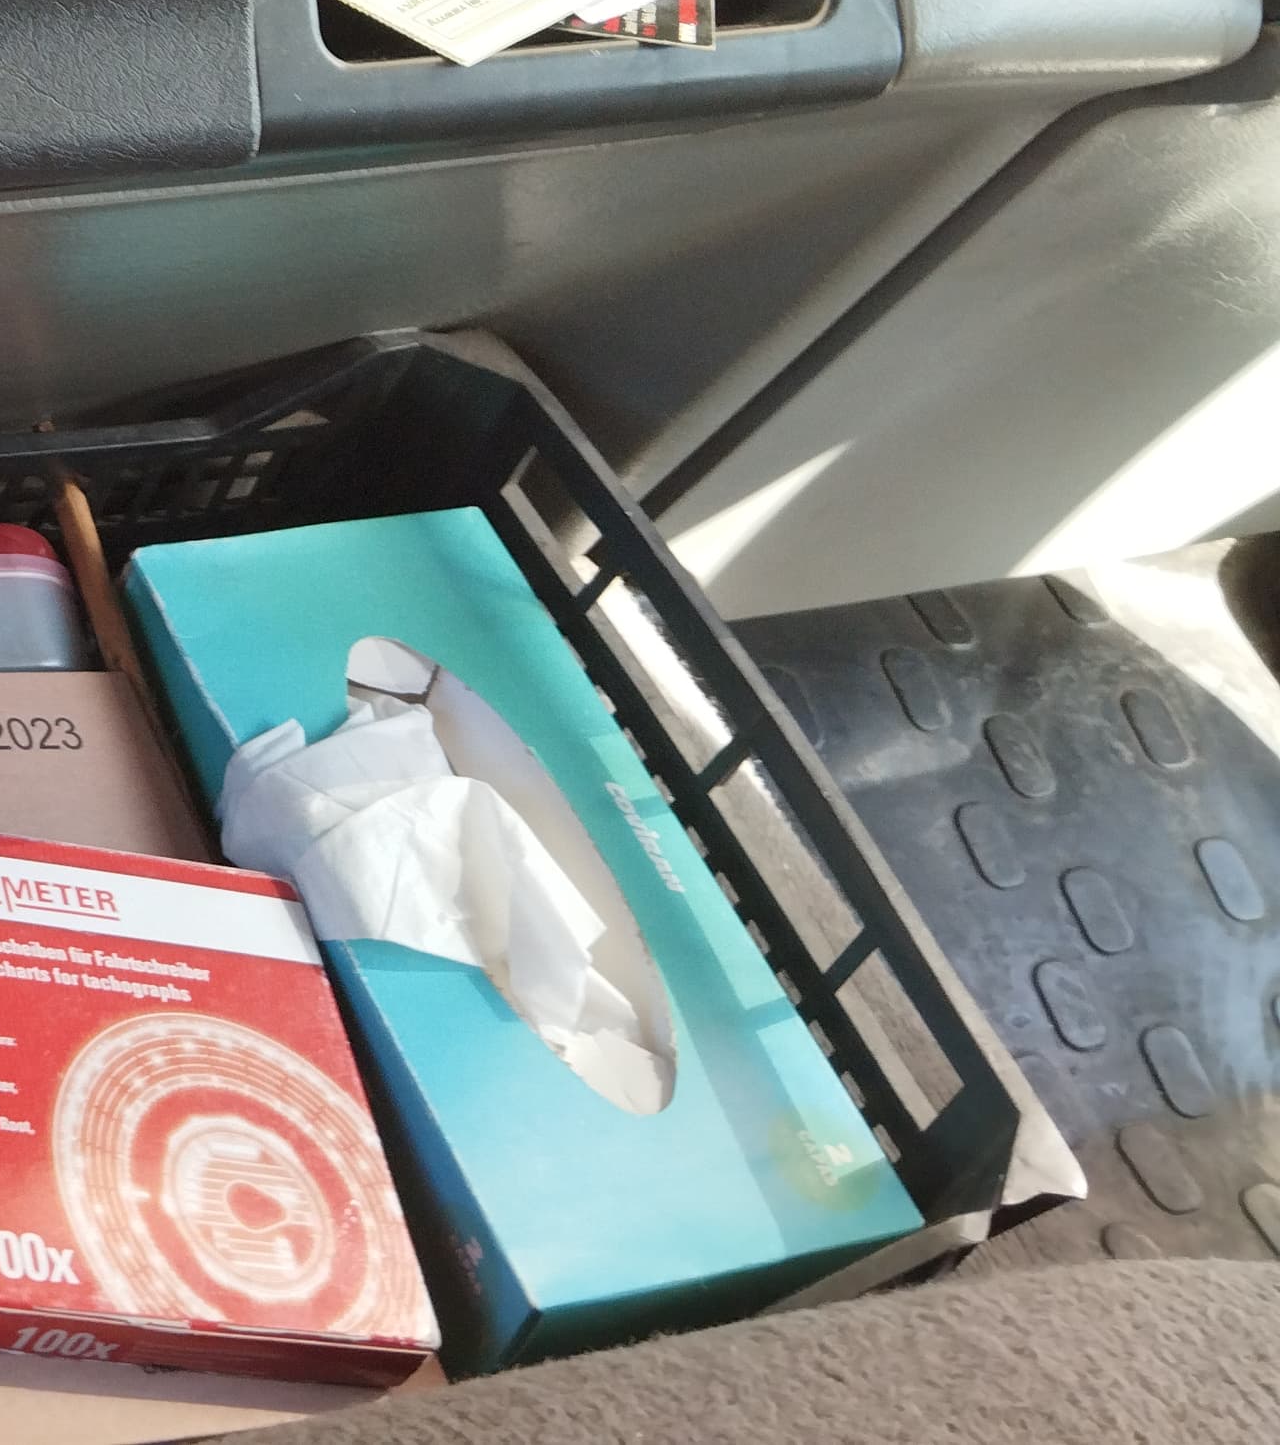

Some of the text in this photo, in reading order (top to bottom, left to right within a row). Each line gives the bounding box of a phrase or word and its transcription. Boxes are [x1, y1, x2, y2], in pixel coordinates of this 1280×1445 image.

[94, 950, 210, 982] Fahrtschreiber
[51, 967, 79, 987] for
[81, 973, 192, 1003] tachographs
[11, 1327, 120, 1360] 100x
